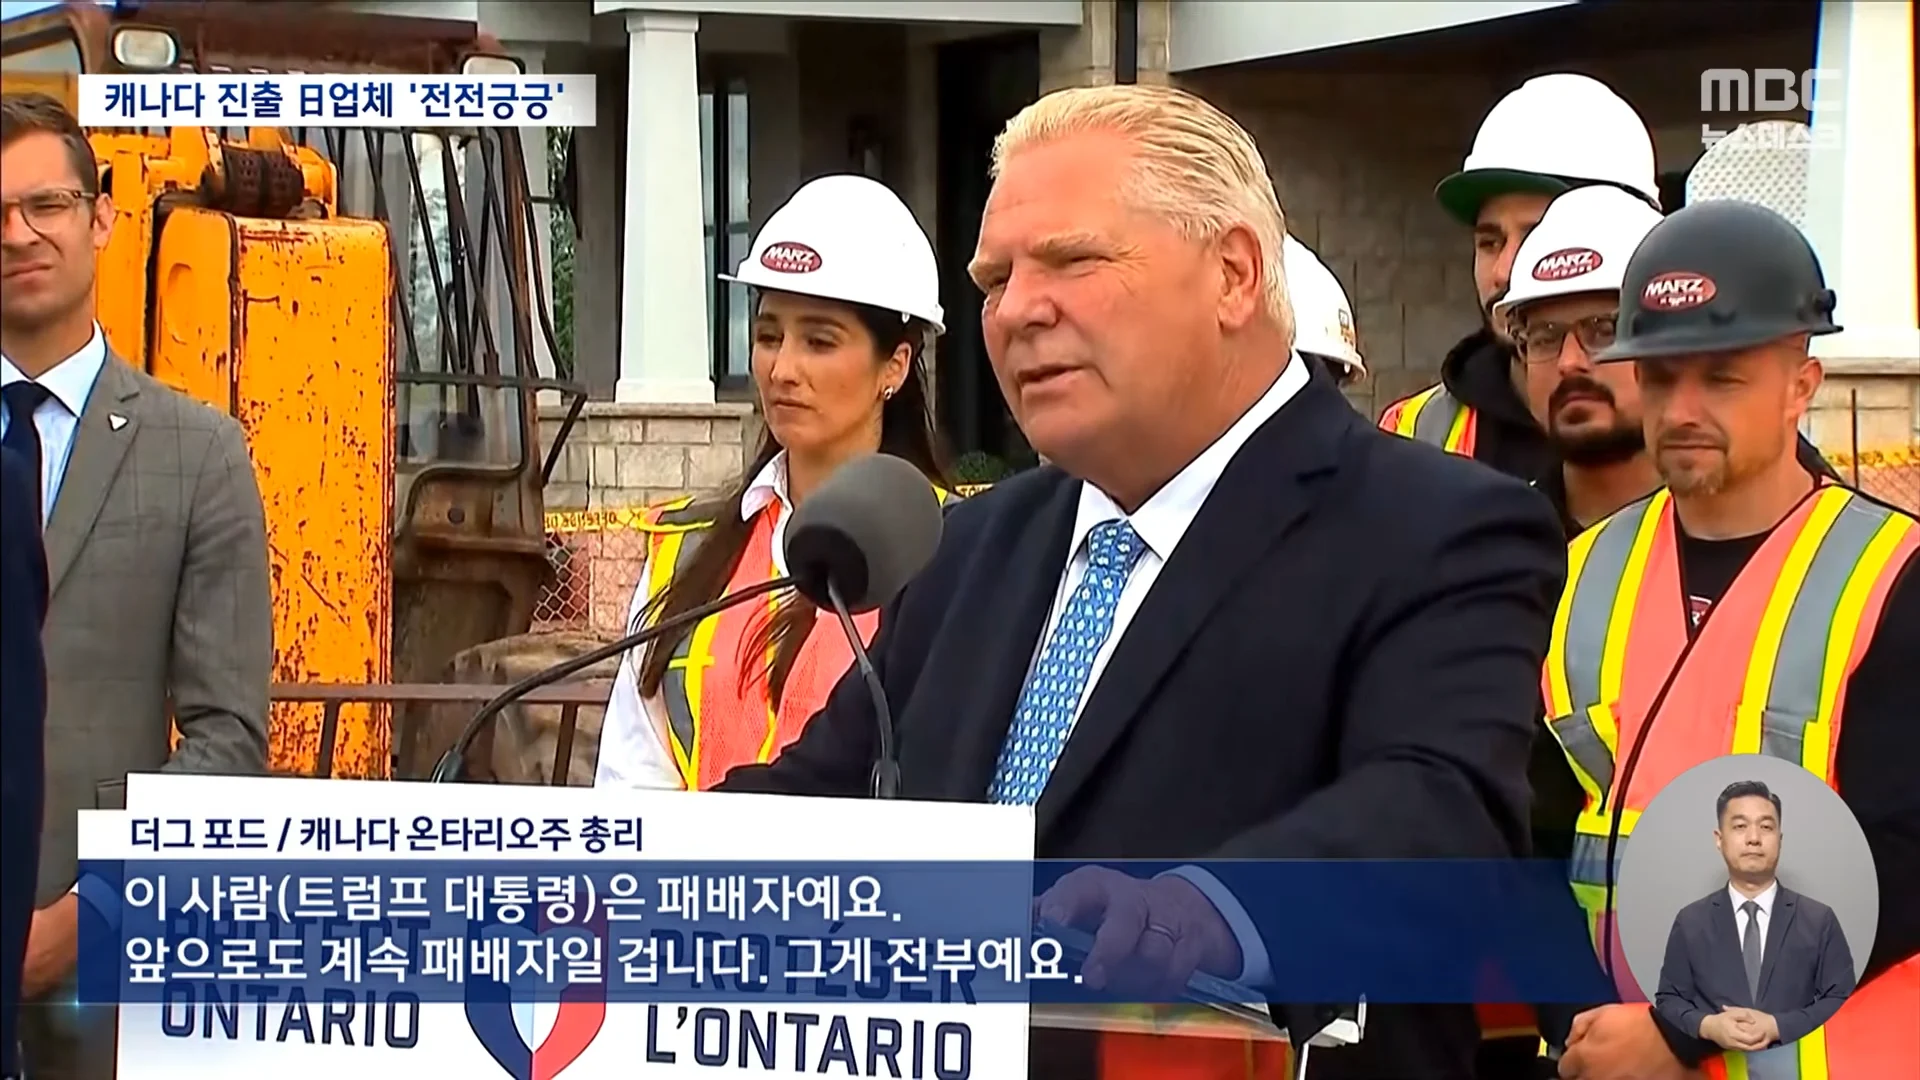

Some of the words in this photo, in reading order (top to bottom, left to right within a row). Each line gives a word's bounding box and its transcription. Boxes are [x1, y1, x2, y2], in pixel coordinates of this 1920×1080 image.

[765, 246, 815, 264] MARZ
[1538, 251, 1593, 275] MARZ
[1645, 279, 1703, 299] MARZ
[161, 981, 420, 1049] ONTARIO
